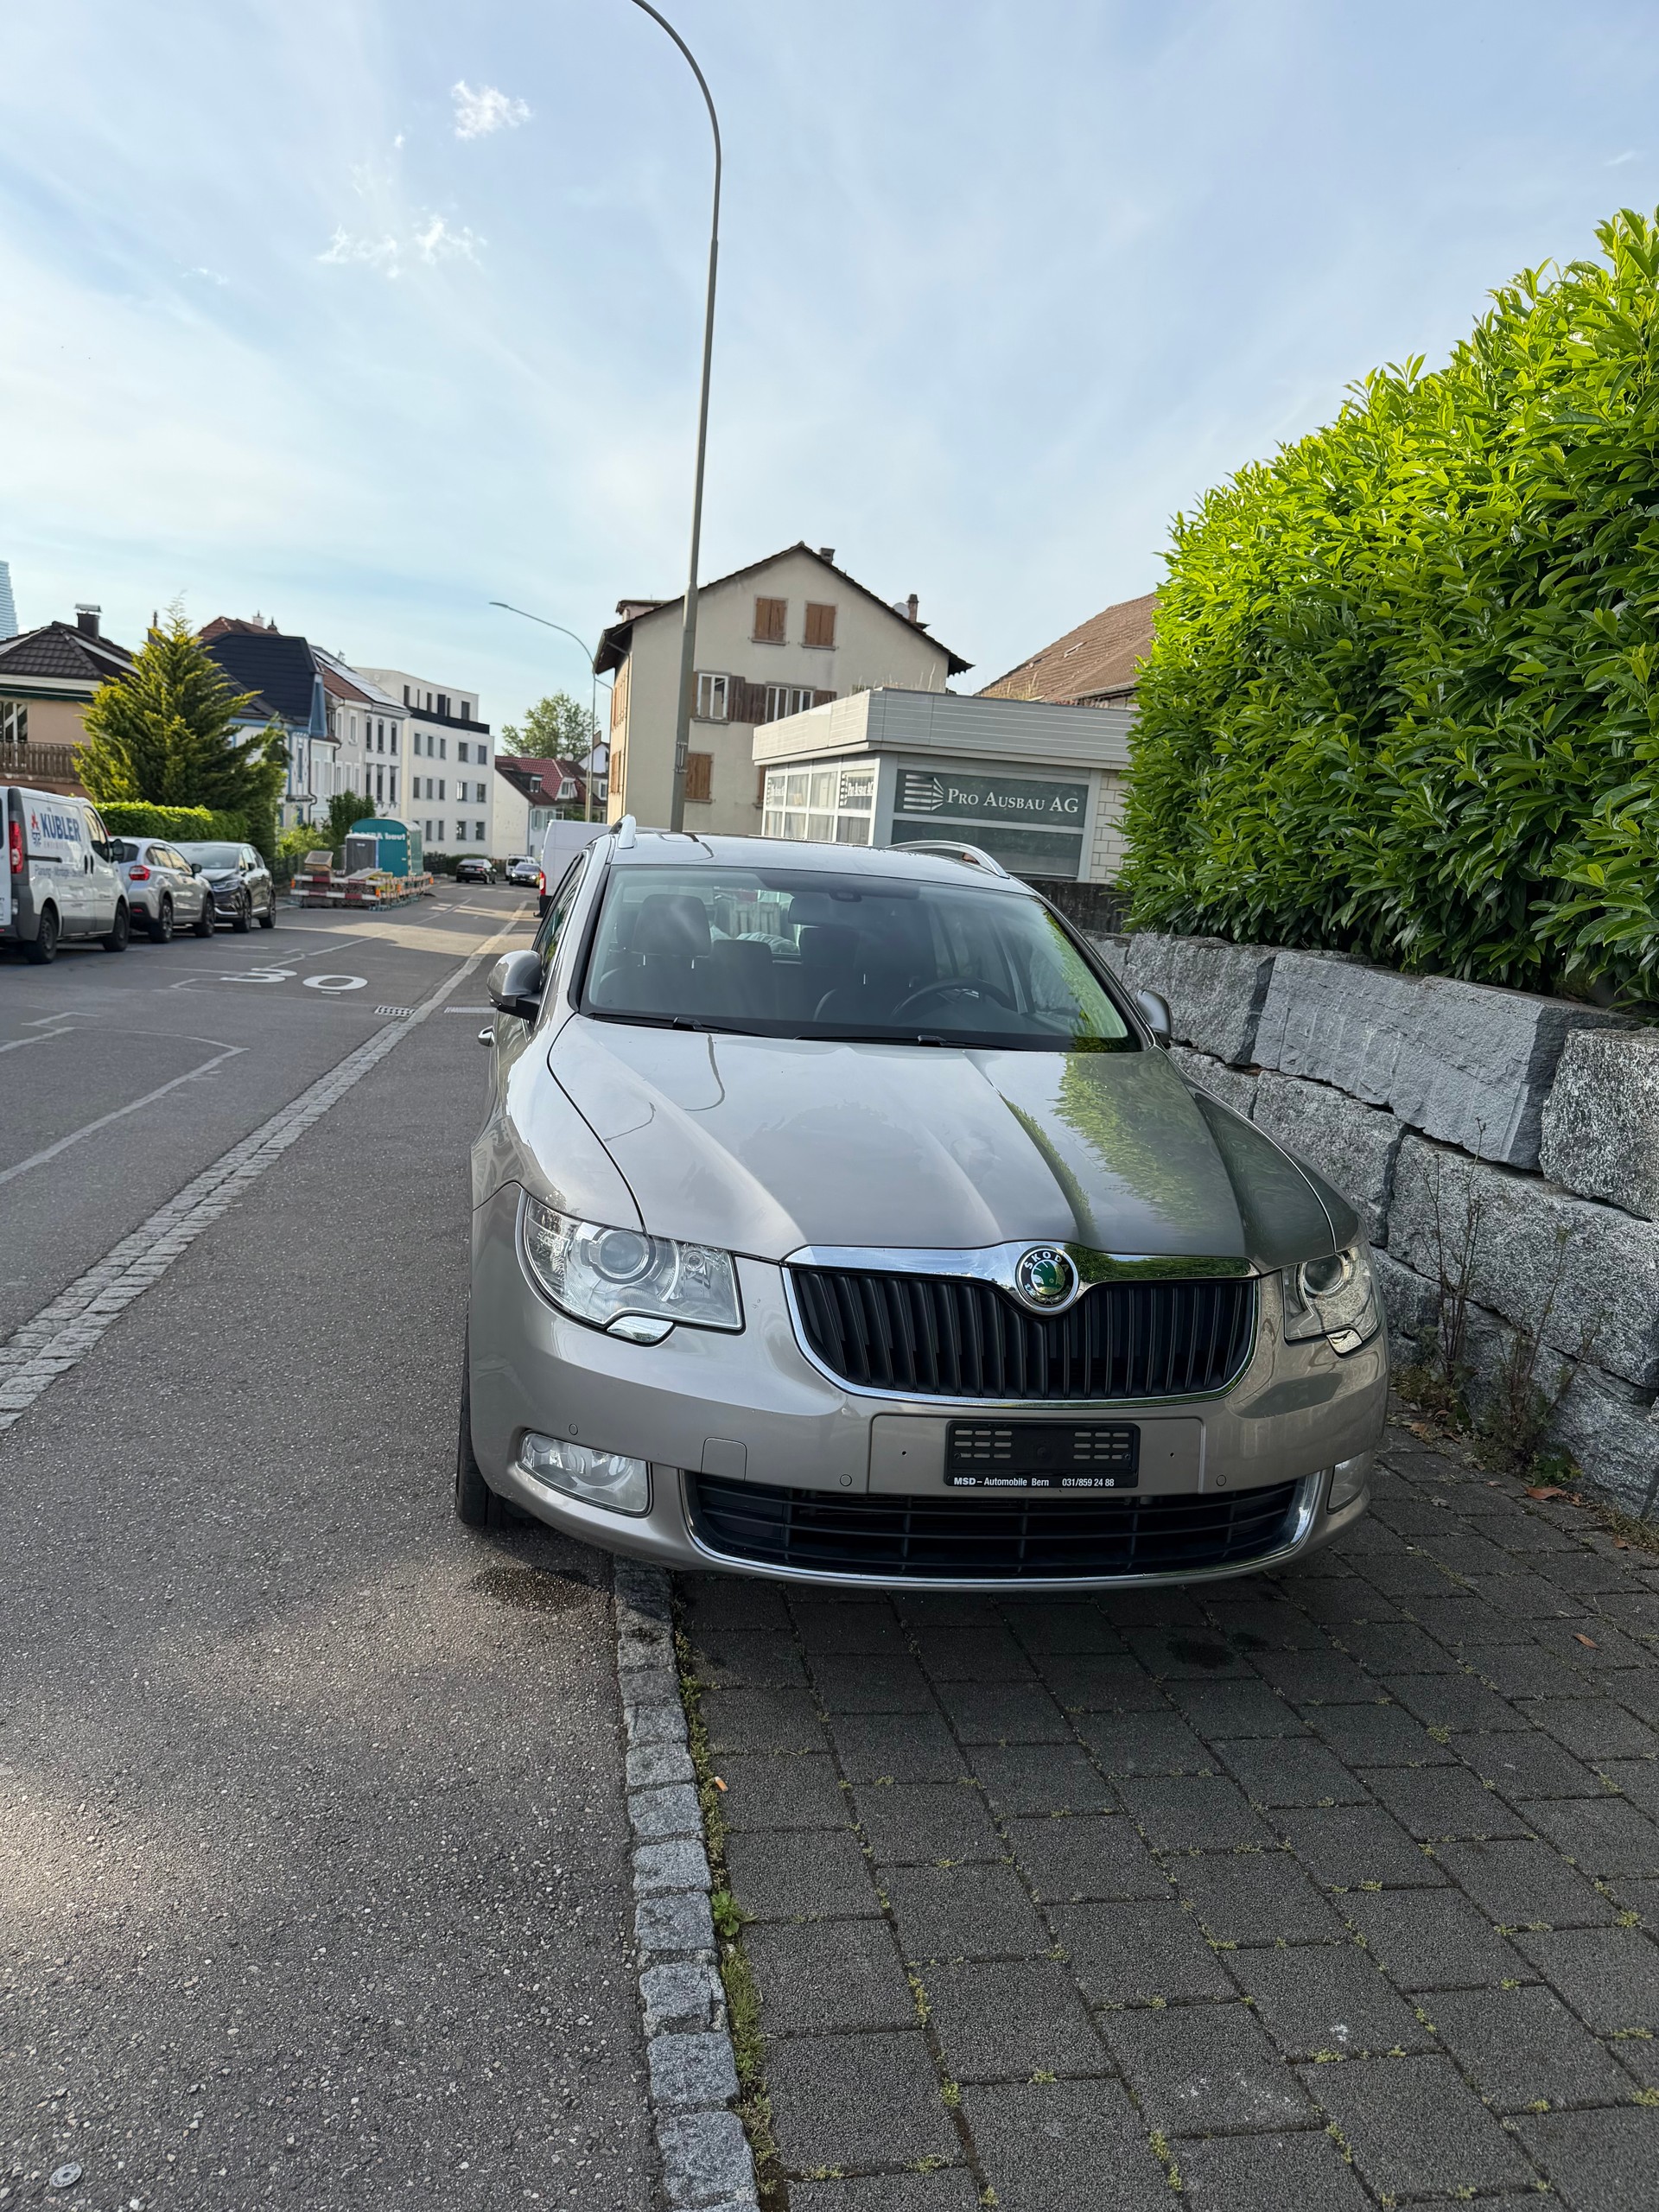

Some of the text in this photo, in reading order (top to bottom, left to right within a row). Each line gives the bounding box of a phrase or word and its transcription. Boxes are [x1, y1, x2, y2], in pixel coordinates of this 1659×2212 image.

[1049, 797, 1079, 813] AG
[219, 967, 368, 990] 30
[983, 1477, 1027, 1486] Automobile
[1031, 1478, 1050, 1486] Bern
[1062, 1478, 1093, 1487] 031/859
[1093, 1478, 1103, 1487] 24
[1104, 1478, 1115, 1487] 88
